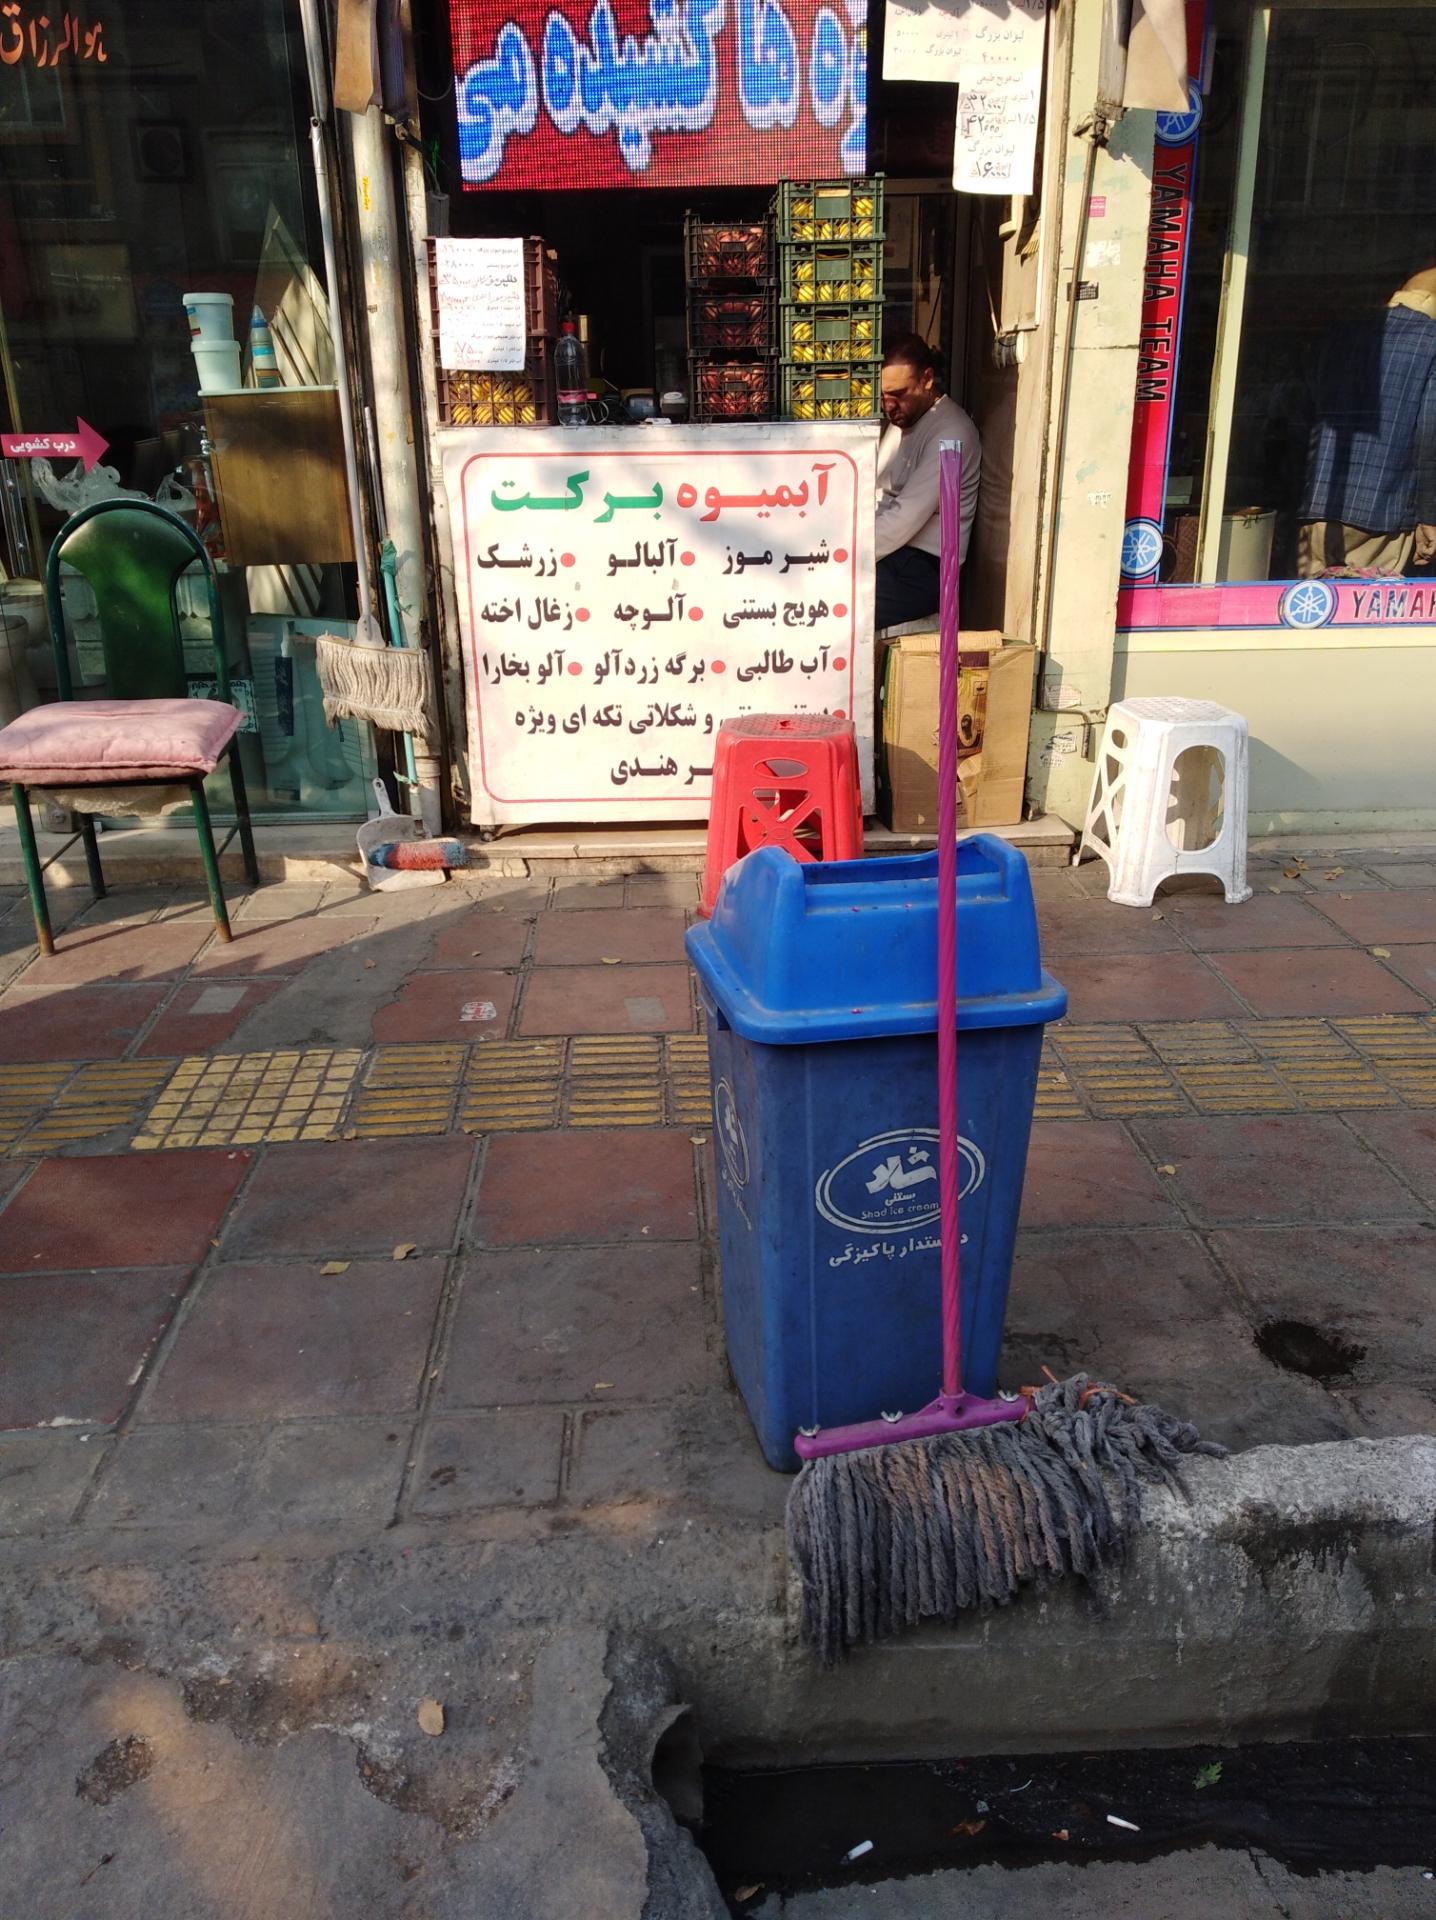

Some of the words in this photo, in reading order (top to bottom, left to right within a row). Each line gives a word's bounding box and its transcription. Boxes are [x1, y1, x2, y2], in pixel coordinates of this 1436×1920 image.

[1144, 163, 1187, 302] YAMAHA
[1136, 316, 1174, 402] TEAM
[10, 437, 50, 453] کشویی
[53, 440, 76, 453] درب
[490, 470, 665, 523] برکت
[676, 462, 836, 522] آبمیوه
[477, 543, 557, 577] زرشک
[606, 538, 678, 577] آلبالو
[721, 544, 773, 574] موز
[778, 538, 830, 574] شیر
[481, 597, 521, 623] اخته
[528, 596, 573, 631] زغال
[613, 593, 687, 631] آلوچه
[722, 599, 777, 629] بستنی
[782, 598, 830, 628] هویج
[482, 652, 530, 685] بخارا
[536, 648, 566, 685] آلو
[665, 652, 706, 684] برگه
[736, 648, 793, 682] طالبی
[799, 645, 831, 676] آب
[515, 705, 557, 734] ویژه
[562, 703, 587, 734] ای
[592, 704, 623, 727] تکه
[629, 702, 697, 735] شکلاتی
[703, 712, 714, 734] و
[611, 754, 678, 785] هندی
[861, 1207, 888, 1219] Shad
[907, 1202, 939, 1213] cream
[829, 1242, 896, 1267] پاکیزگی
